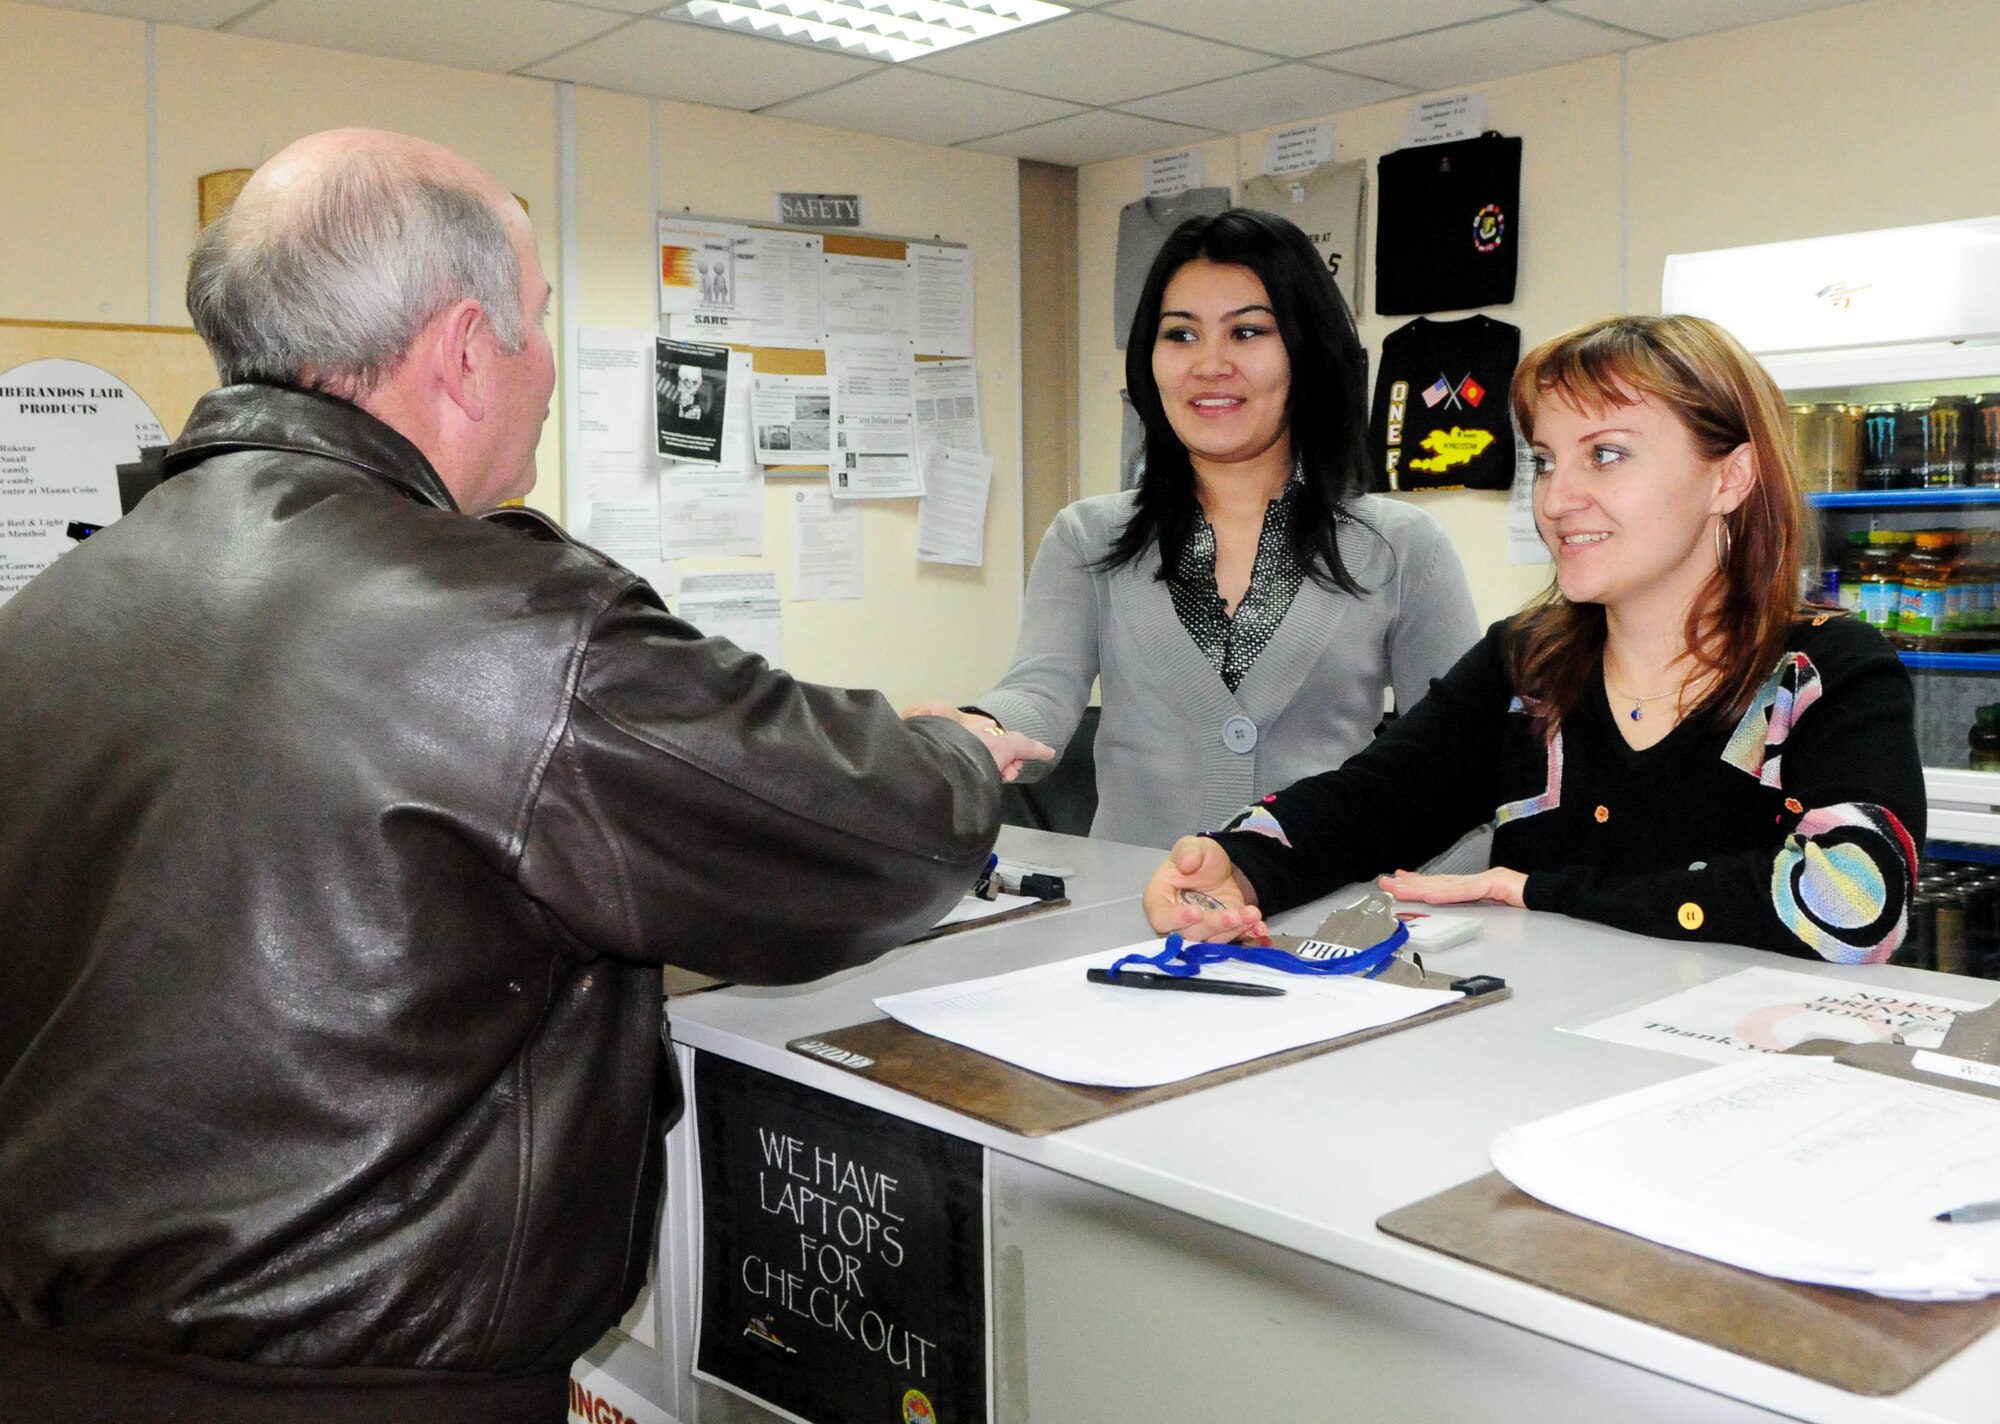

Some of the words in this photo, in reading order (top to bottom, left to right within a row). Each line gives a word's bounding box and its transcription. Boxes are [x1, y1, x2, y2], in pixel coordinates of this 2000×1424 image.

[781, 198, 858, 219] SAFETY
[1321, 231, 1332, 243] AT
[694, 314, 729, 326] SARC
[90, 387, 124, 399] LAIR
[19, 403, 98, 415] PRODUCTS
[0, 455, 27, 463] Small
[2, 466, 30, 475] candy
[7, 477, 34, 486] candy
[0, 487, 27, 495] enter
[28, 486, 38, 495] at
[40, 486, 71, 494] Manas
[7, 519, 26, 527] Red
[28, 519, 36, 527] &
[40, 519, 64, 528] Light
[8, 530, 46, 538] Menthol
[1849, 992, 1899, 1004] NO
[1643, 1020, 1736, 1046] Thank
[1959, 1062, 2000, 1080] WI-F
[759, 1127, 810, 1181] WE
[815, 1146, 904, 1222] HAVE
[760, 1172, 904, 1267] LAPTOPS
[800, 1234, 864, 1298] FOR
[742, 1255, 855, 1340] CHECK
[860, 1310, 937, 1378] OUT
